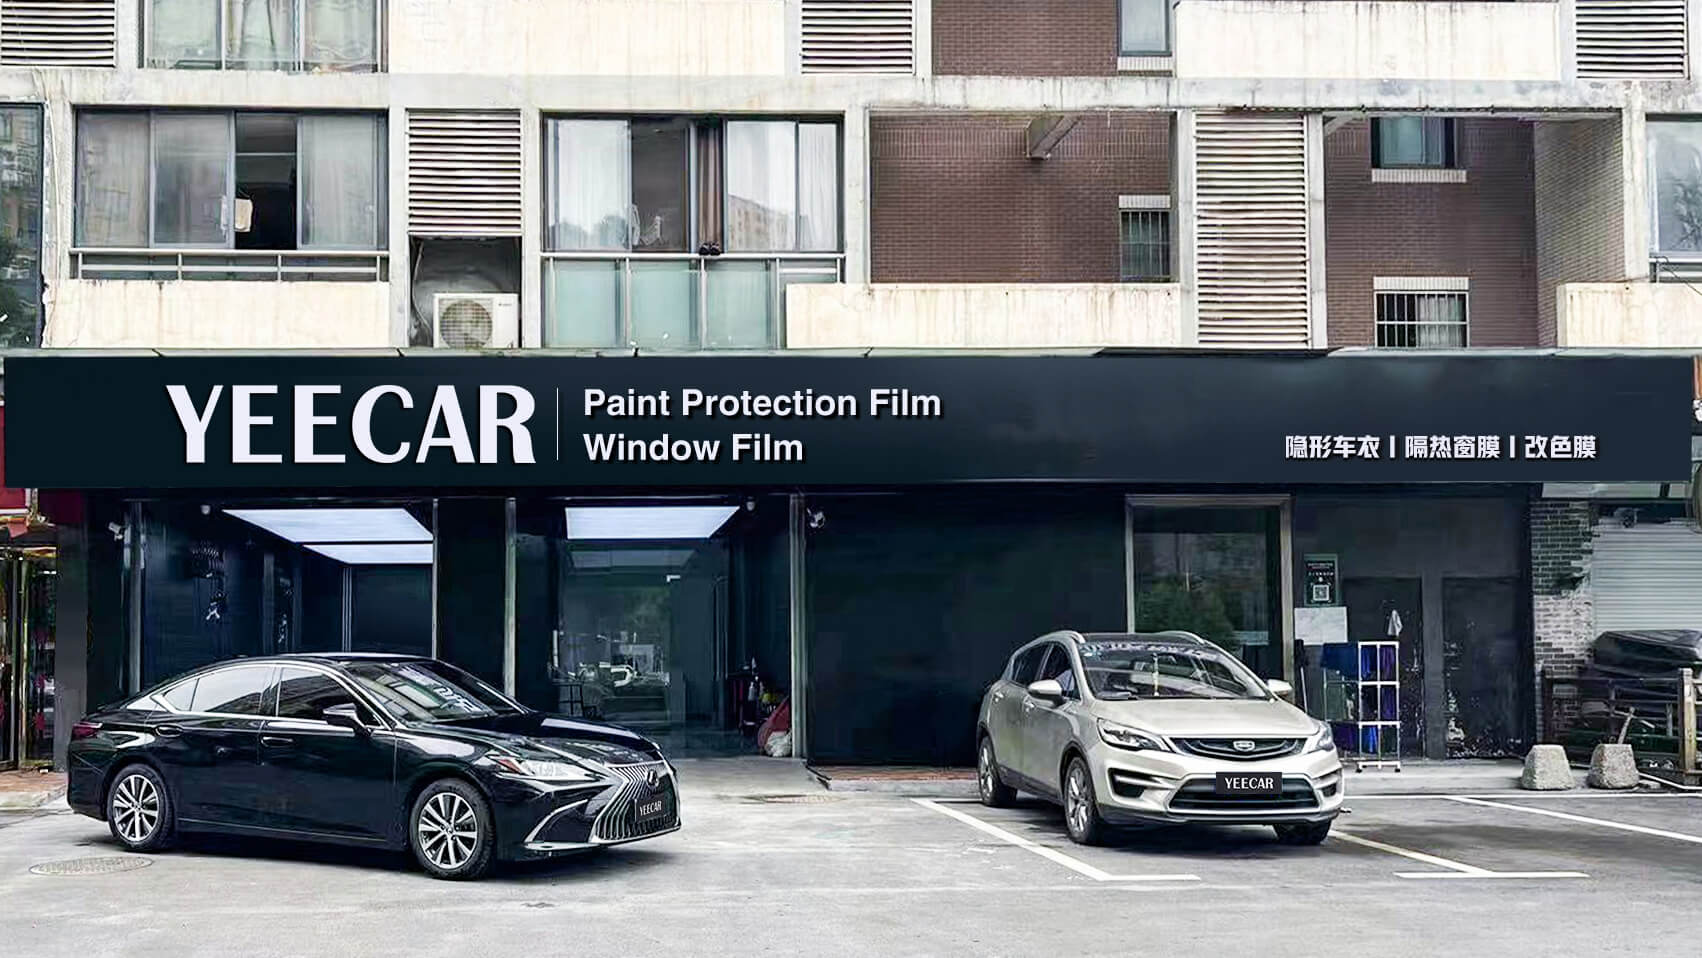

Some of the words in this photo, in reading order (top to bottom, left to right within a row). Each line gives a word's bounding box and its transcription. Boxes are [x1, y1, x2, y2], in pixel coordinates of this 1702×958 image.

[583, 388, 670, 417] Paint
[681, 388, 858, 417] Protection
[869, 388, 942, 417] Film
[167, 384, 537, 464] YEECAR
[582, 432, 722, 462] Window
[731, 432, 804, 462] Film
[1285, 434, 1380, 460] 隐形车衣
[1405, 434, 1501, 460] 隔热窗膜
[1524, 434, 1597, 460] 改色膜
[1224, 776, 1275, 790] YEECAR
